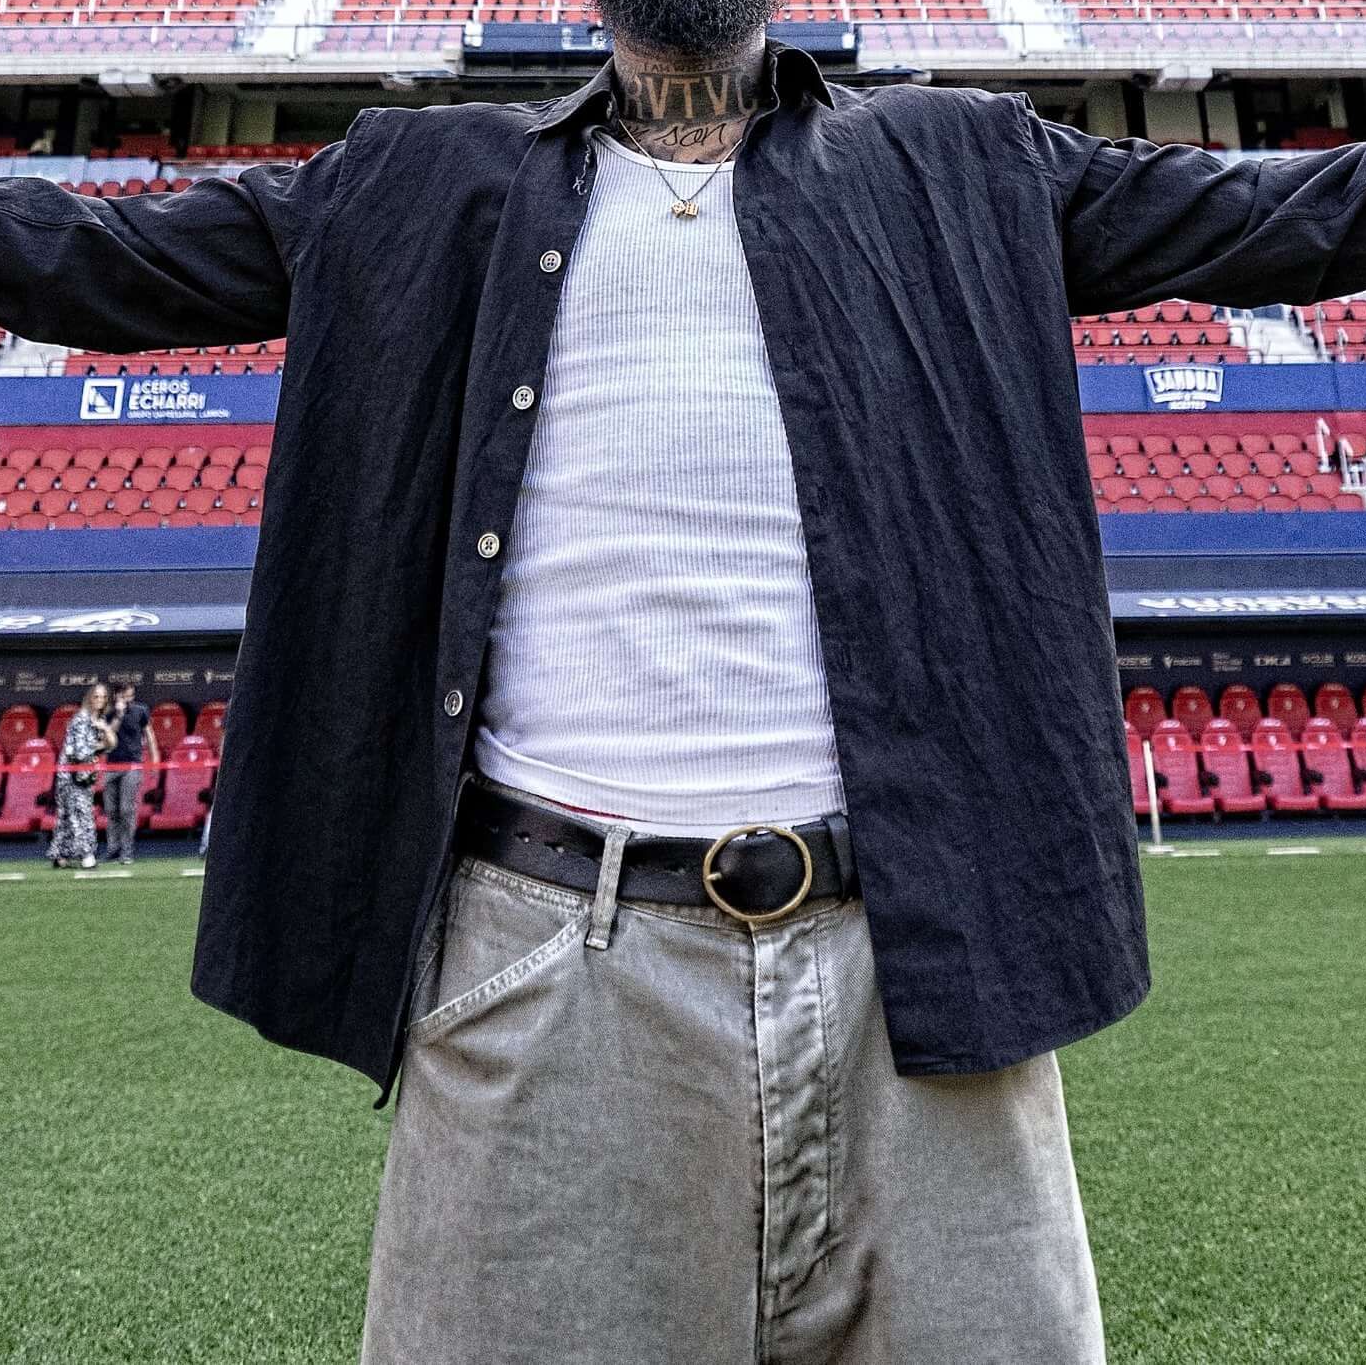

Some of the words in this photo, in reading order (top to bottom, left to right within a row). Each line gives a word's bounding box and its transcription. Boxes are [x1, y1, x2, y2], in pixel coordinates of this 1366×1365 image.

[131, 380, 190, 395] ACEROS
[1152, 369, 1218, 392] SANDUA
[128, 393, 206, 410] ECHARRI
